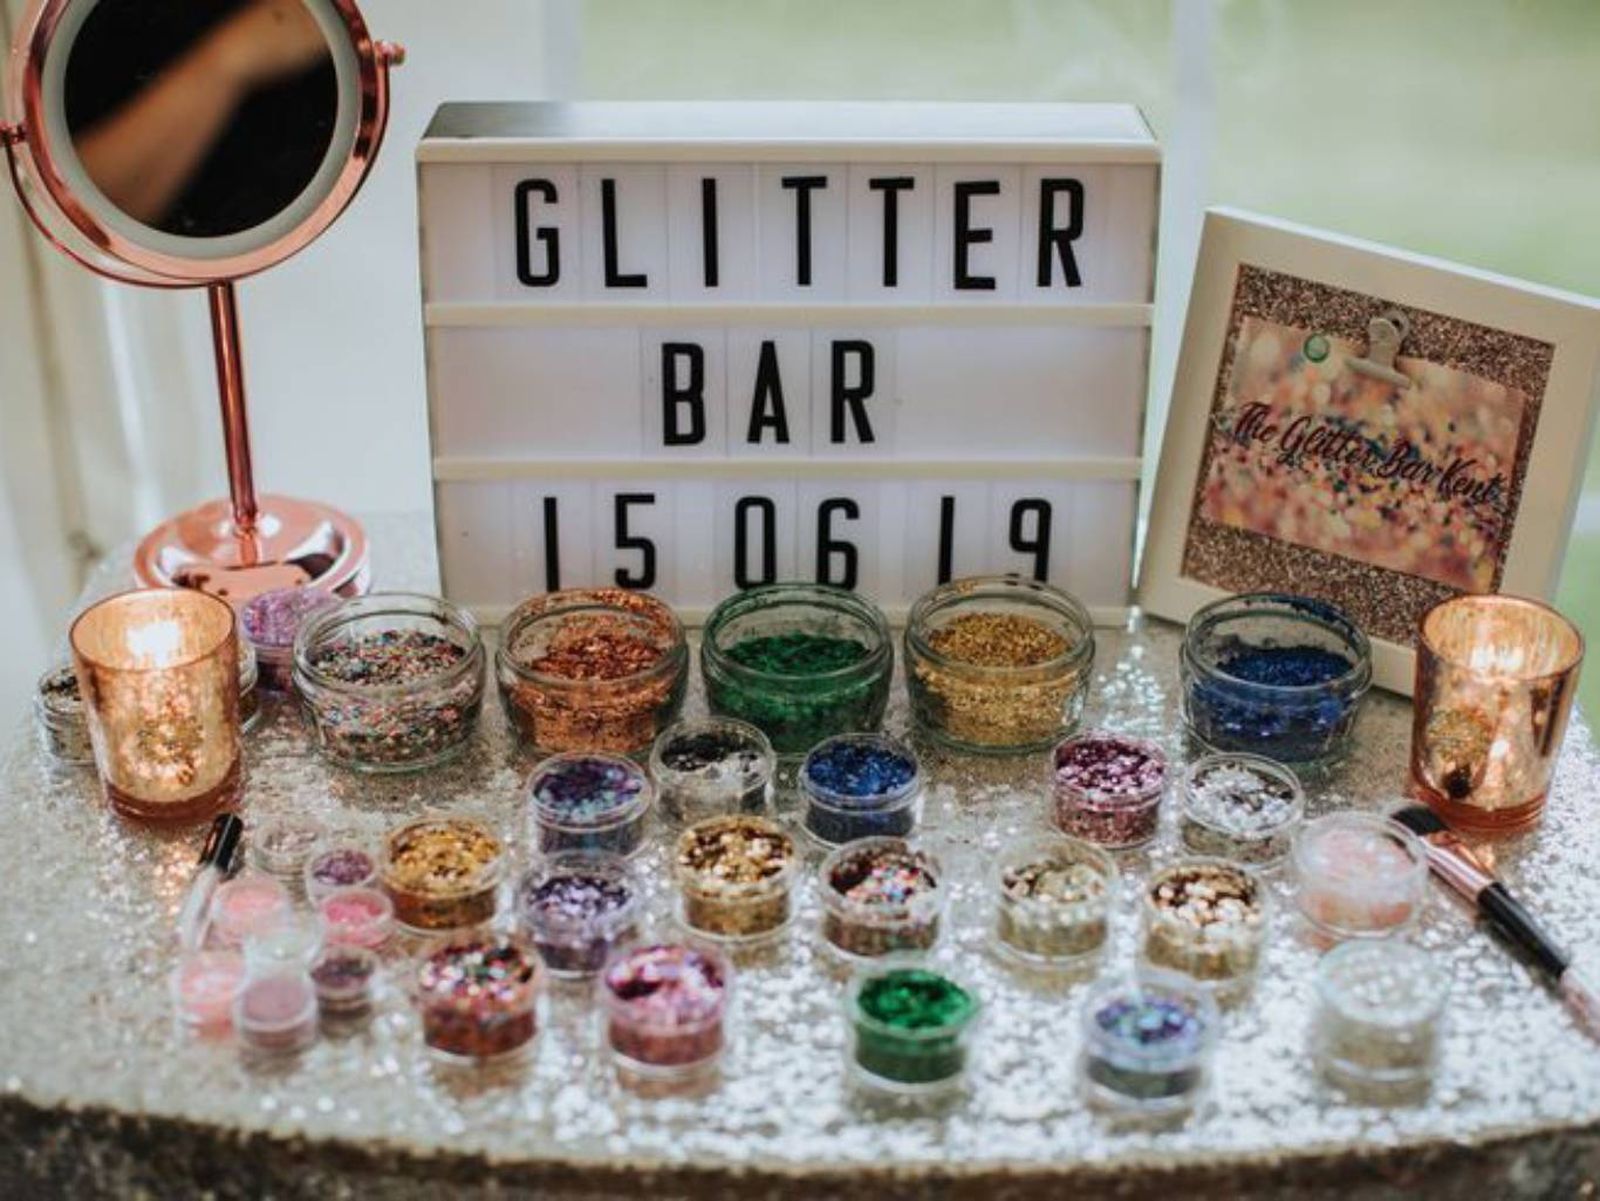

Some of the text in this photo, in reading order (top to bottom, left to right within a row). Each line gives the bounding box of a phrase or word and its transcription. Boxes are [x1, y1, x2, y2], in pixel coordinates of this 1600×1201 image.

[514, 176, 1085, 290] GLITTER
[661, 340, 875, 446] BAR
[1233, 401, 1504, 502] The Glitter Bar Kent
[543, 493, 656, 591] 15
[734, 495, 860, 591] 06
